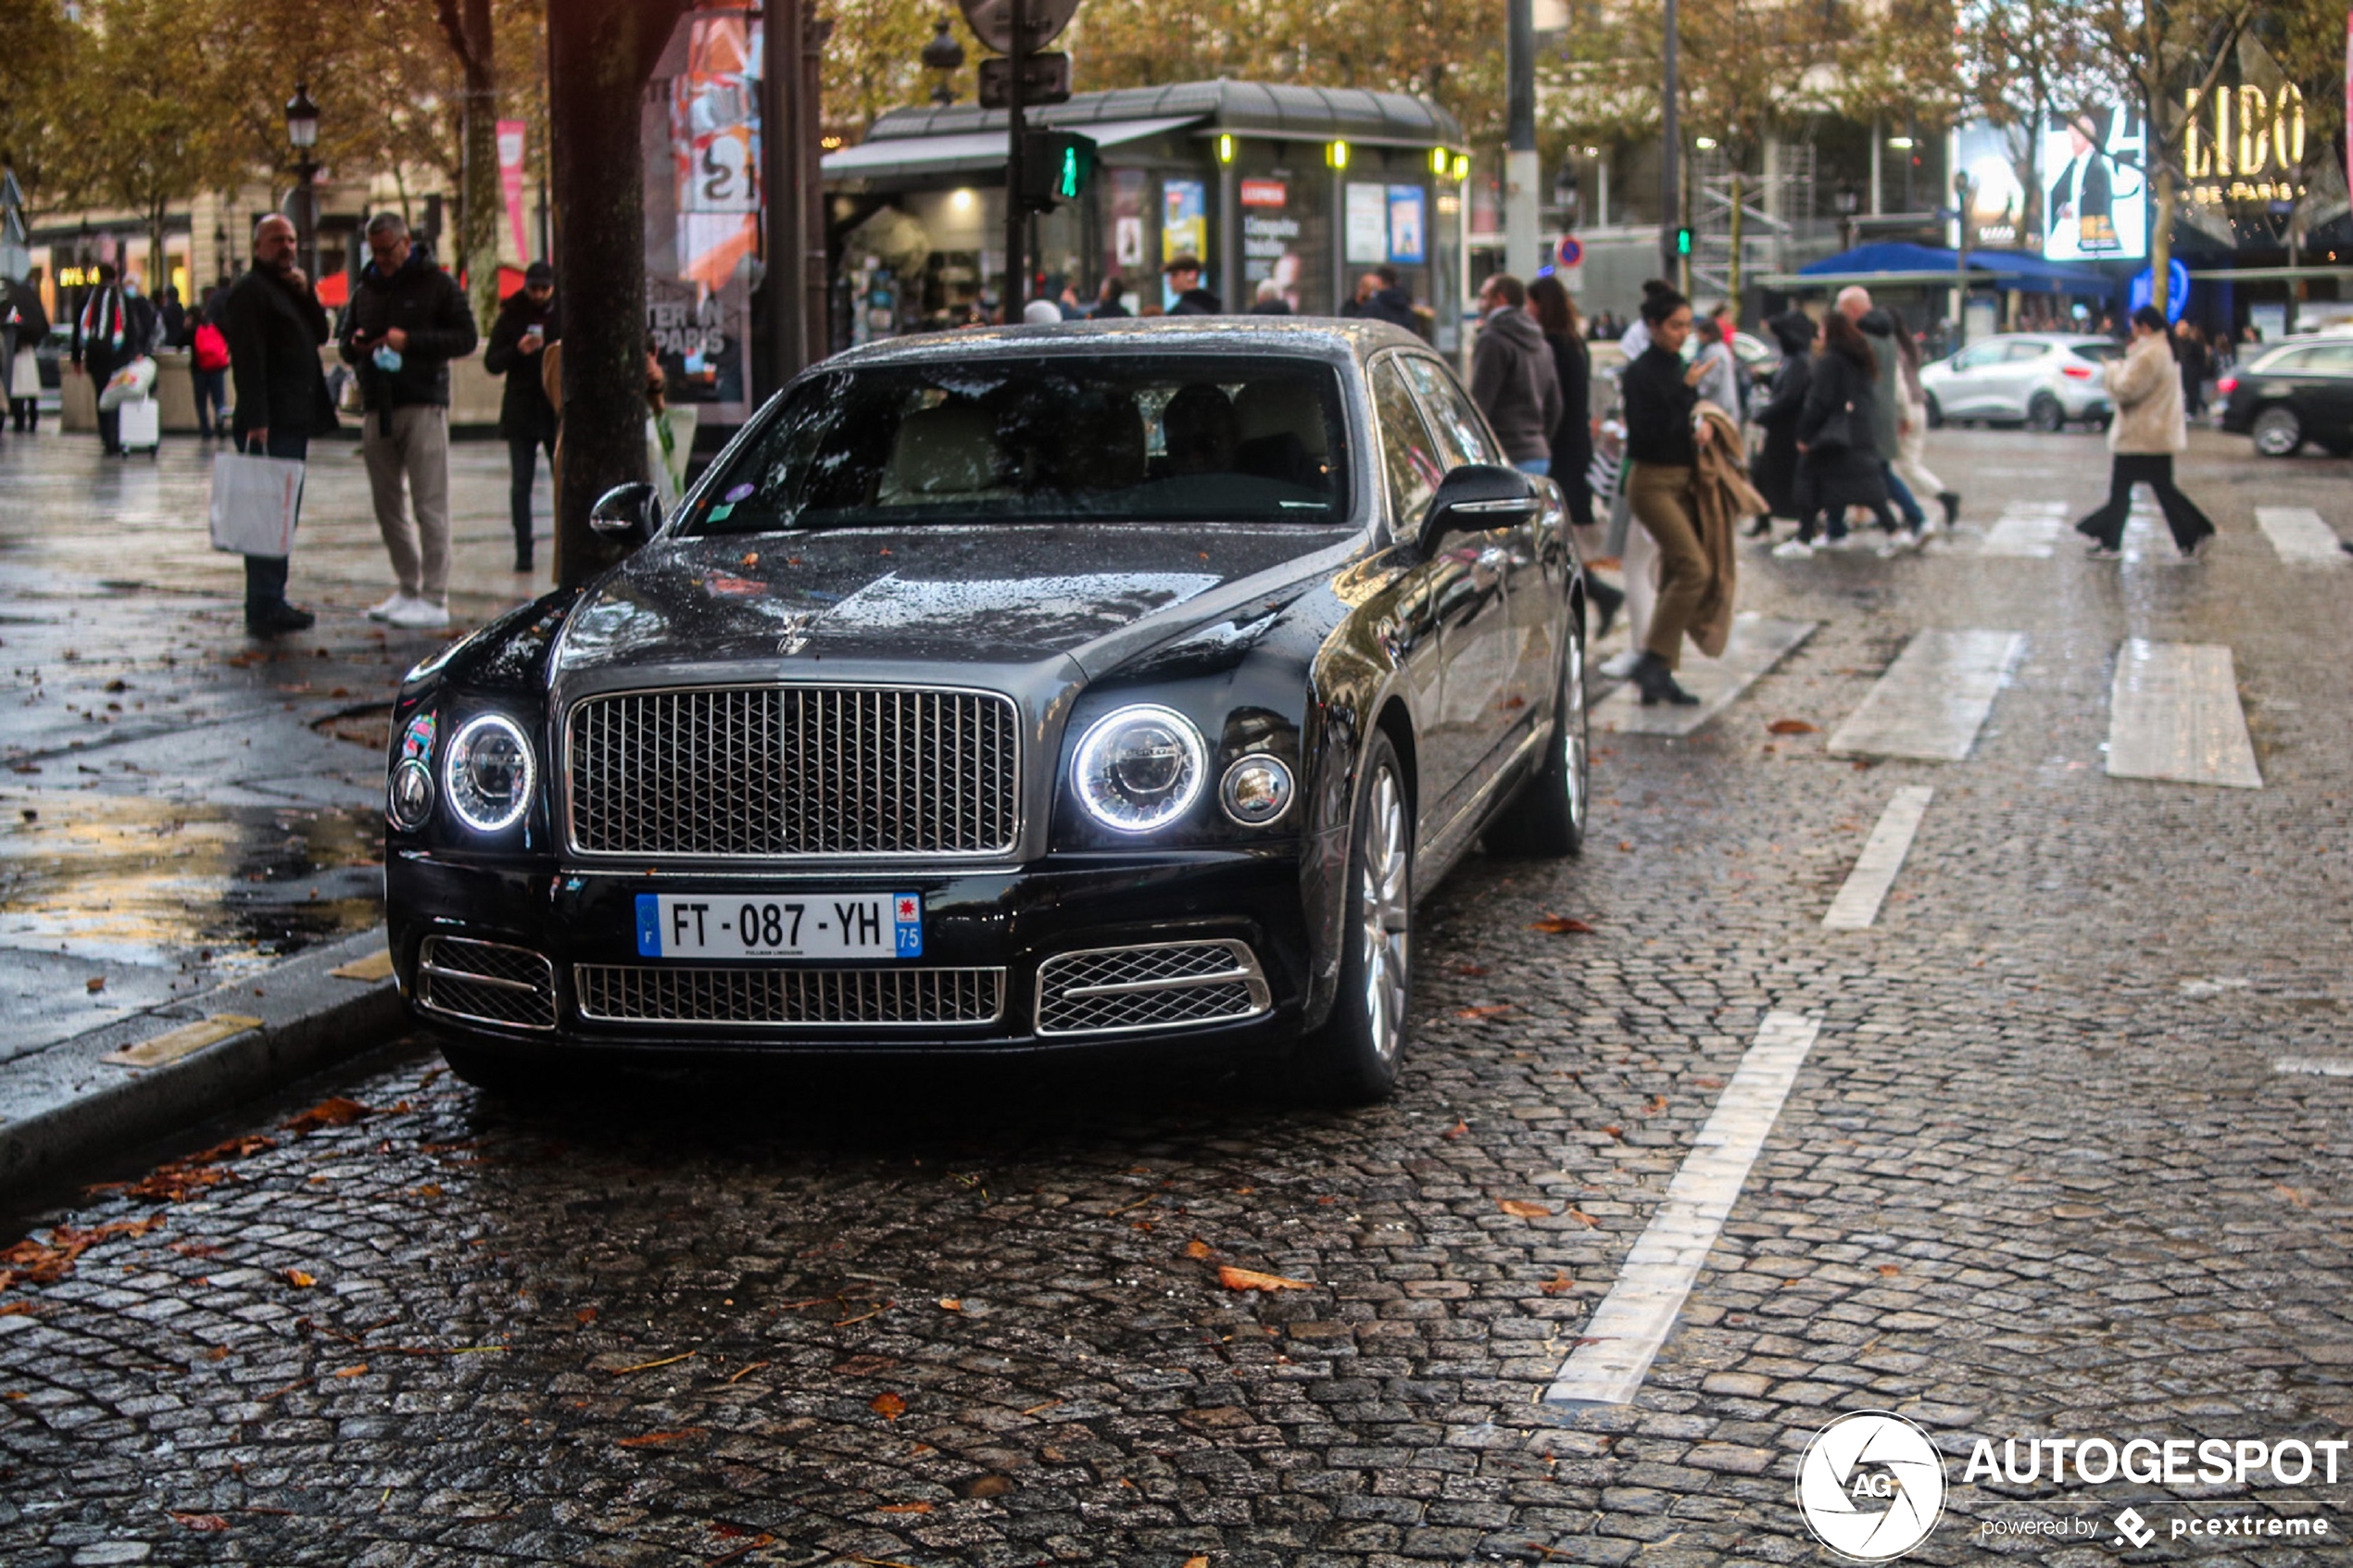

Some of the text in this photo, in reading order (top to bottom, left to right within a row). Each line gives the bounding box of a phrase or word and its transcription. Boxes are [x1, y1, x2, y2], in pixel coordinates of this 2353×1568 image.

[2185, 81, 2305, 178] LIDO
[2194, 182, 2293, 204] DE PARIS
[651, 328, 724, 355] PARIS
[645, 931, 652, 943] F
[899, 928, 919, 947] 75
